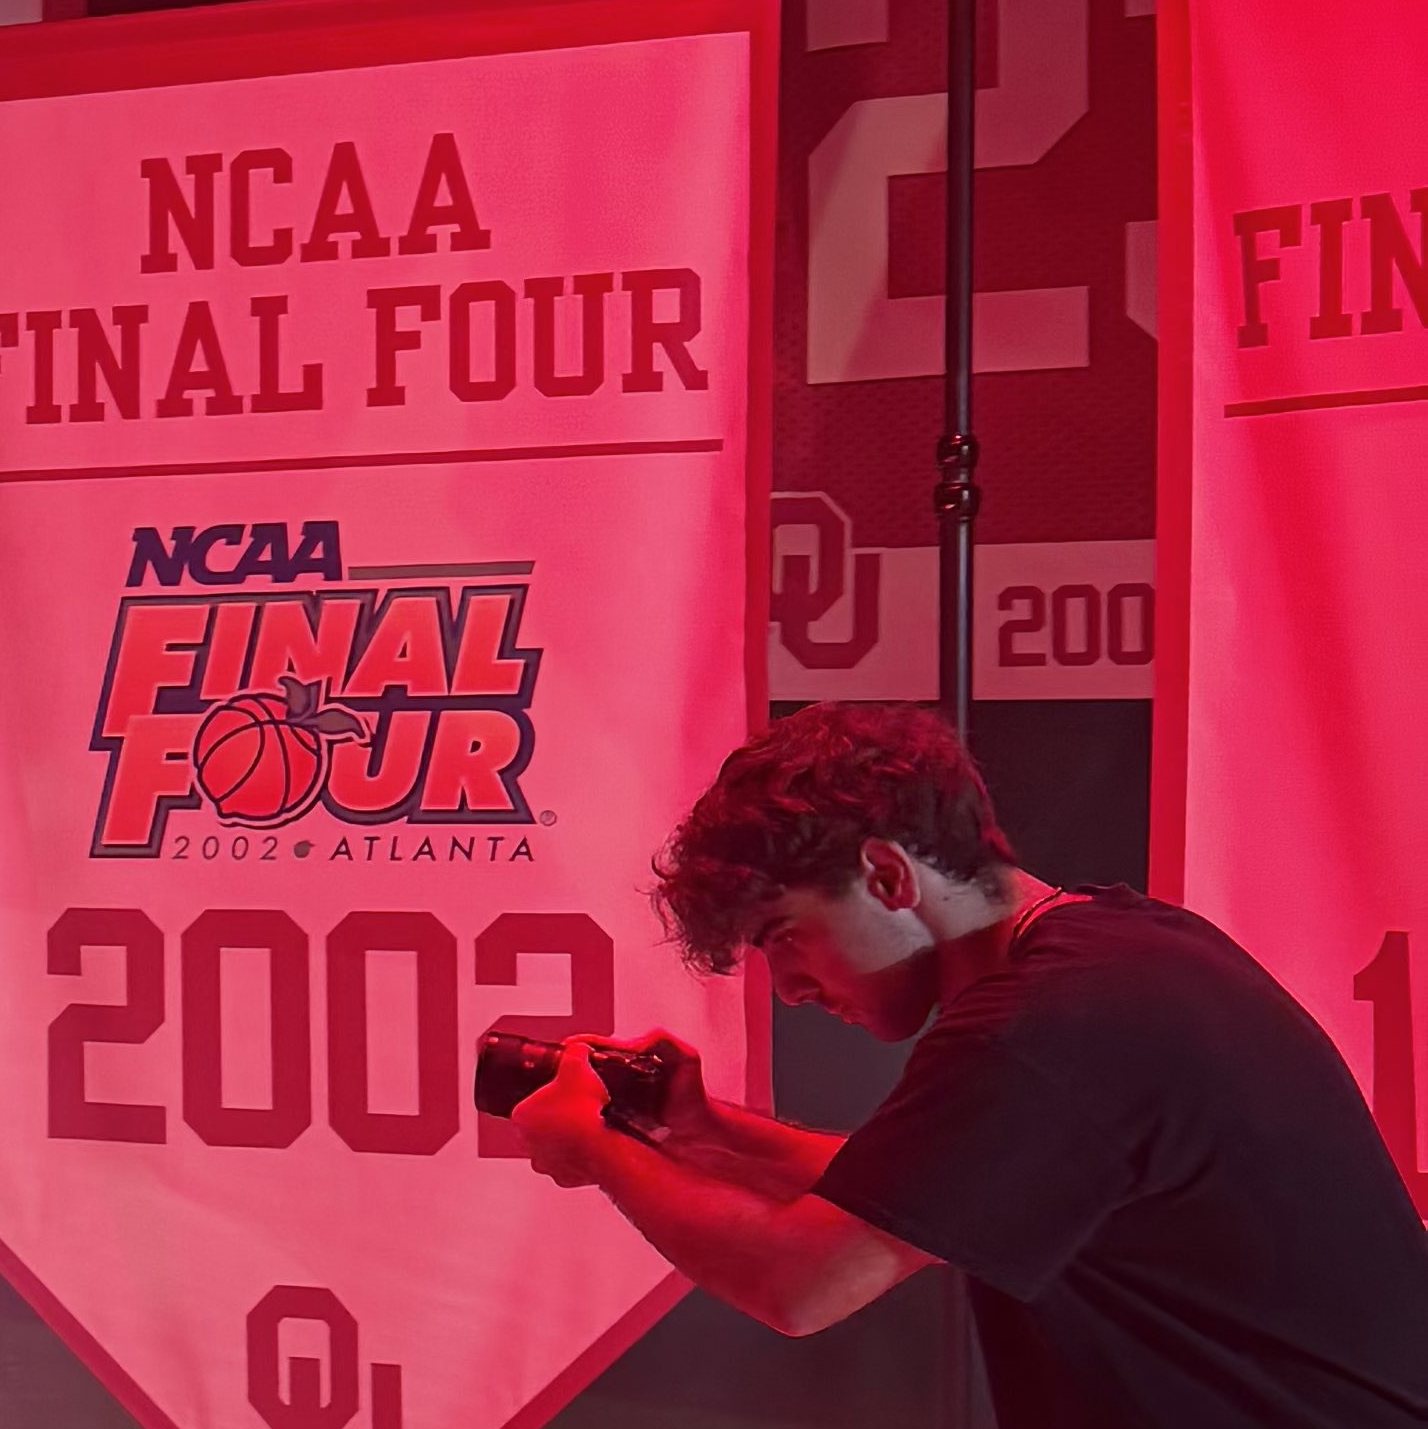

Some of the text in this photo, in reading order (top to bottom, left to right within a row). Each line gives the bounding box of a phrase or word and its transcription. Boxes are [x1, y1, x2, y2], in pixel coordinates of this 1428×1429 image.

[140, 132, 492, 274] NCAA
[365, 267, 709, 407] FOUR
[126, 520, 343, 588] NCAA
[770, 495, 882, 670] OU
[94, 584, 541, 748] FINAL
[172, 835, 536, 862] 2002 ATLANTA
[47, 907, 614, 1159] 2002
